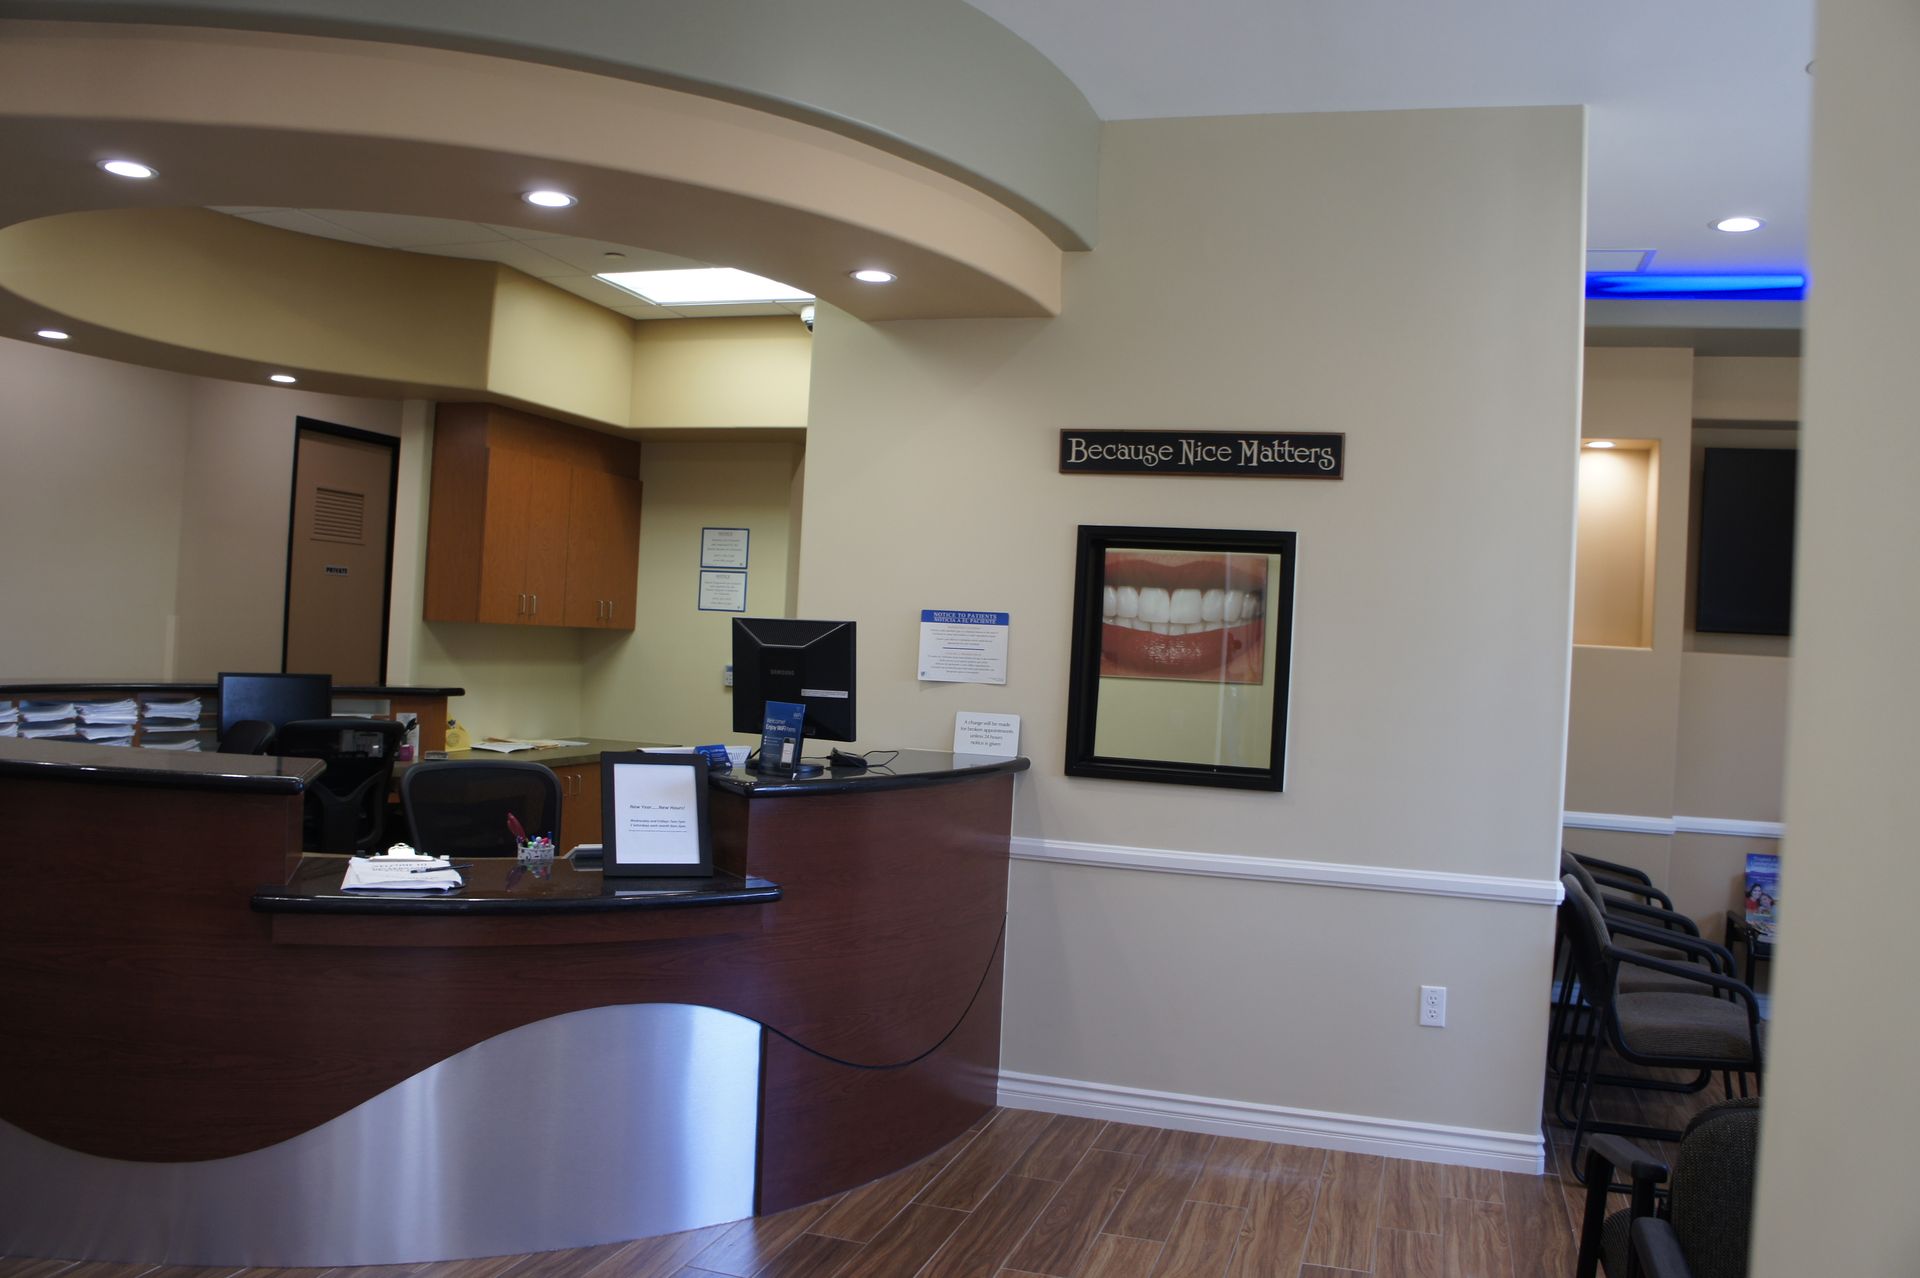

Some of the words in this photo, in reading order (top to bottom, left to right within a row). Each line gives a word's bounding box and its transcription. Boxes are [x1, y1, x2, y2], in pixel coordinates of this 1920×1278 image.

[1067, 437, 1174, 467] Because
[1177, 439, 1233, 466] Nice
[1237, 439, 1336, 471] Matters
